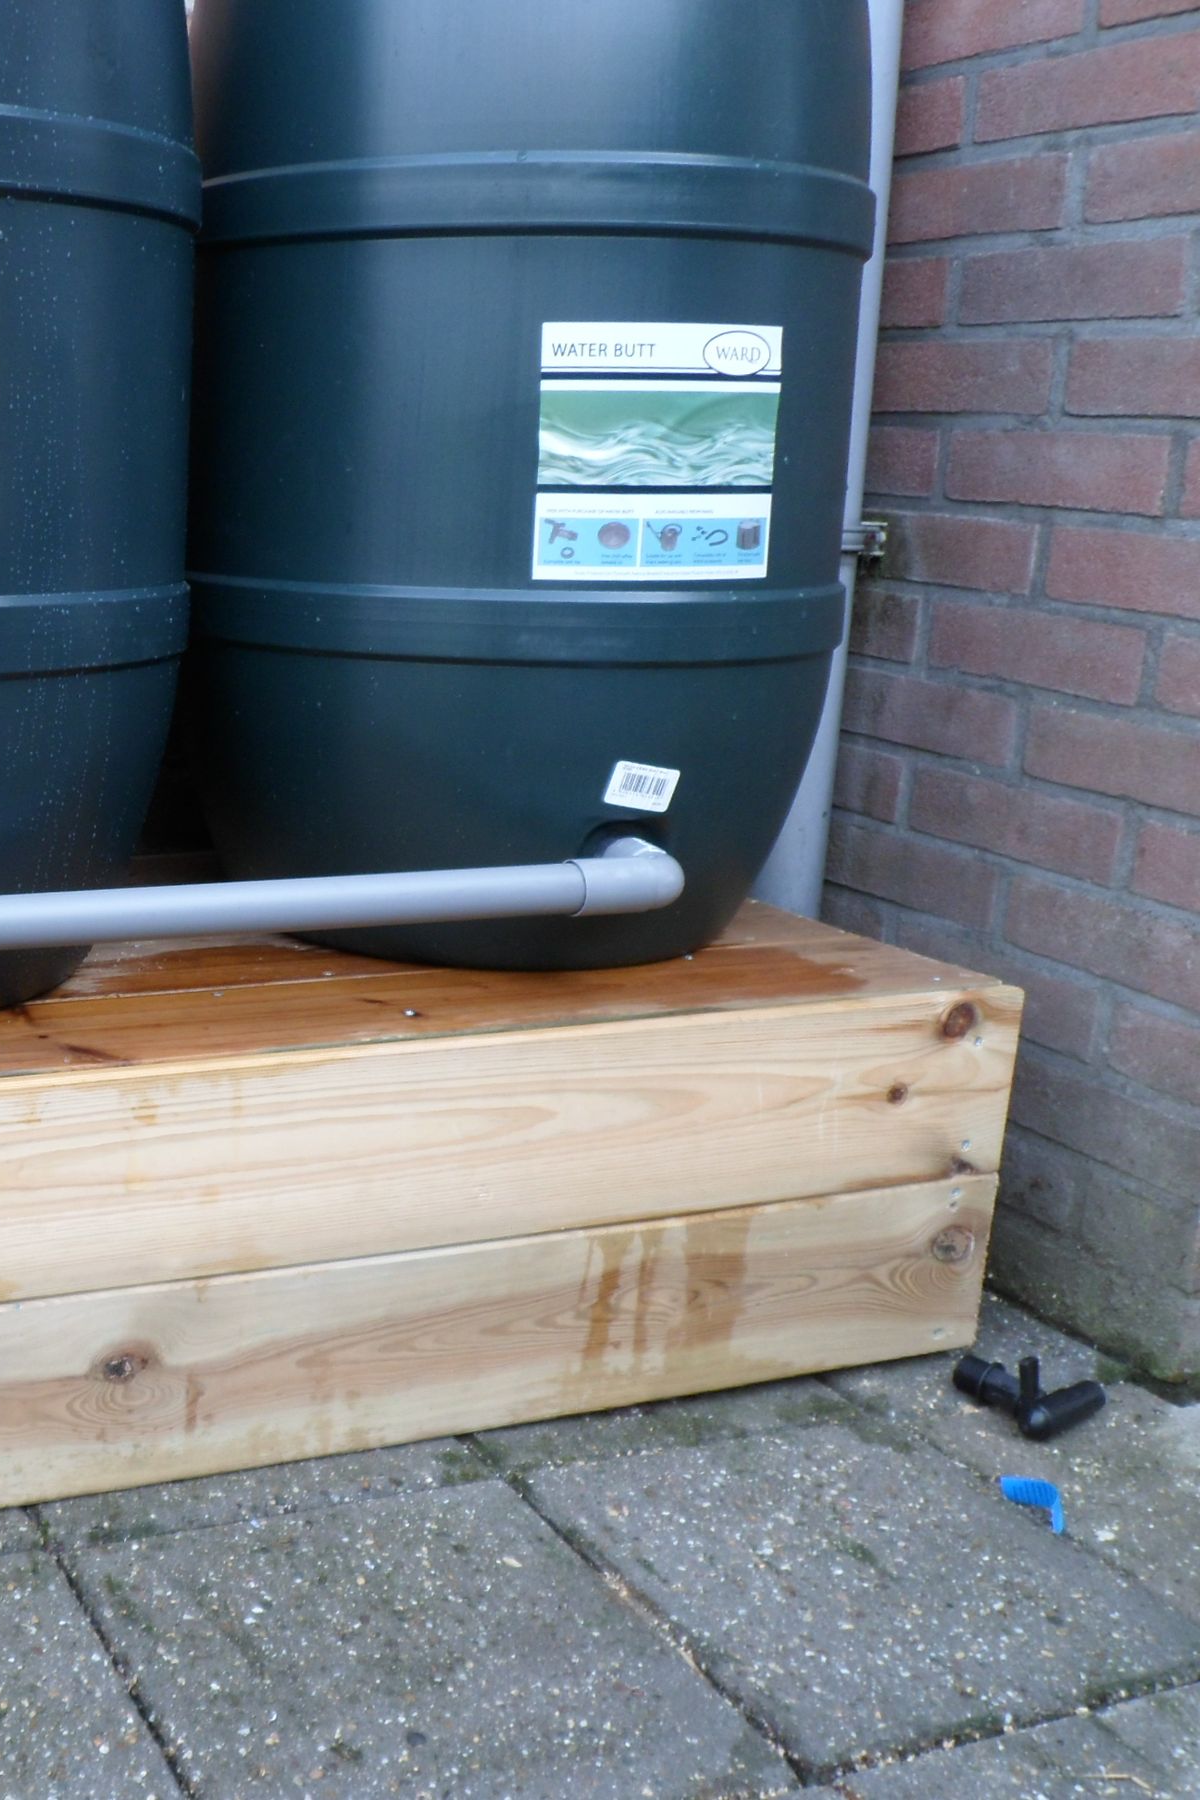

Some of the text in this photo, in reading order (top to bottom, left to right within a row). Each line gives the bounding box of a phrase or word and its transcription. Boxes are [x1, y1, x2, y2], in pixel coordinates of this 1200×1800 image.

[551, 343, 657, 358] WATER BUTT
[715, 345, 761, 363] WARD
